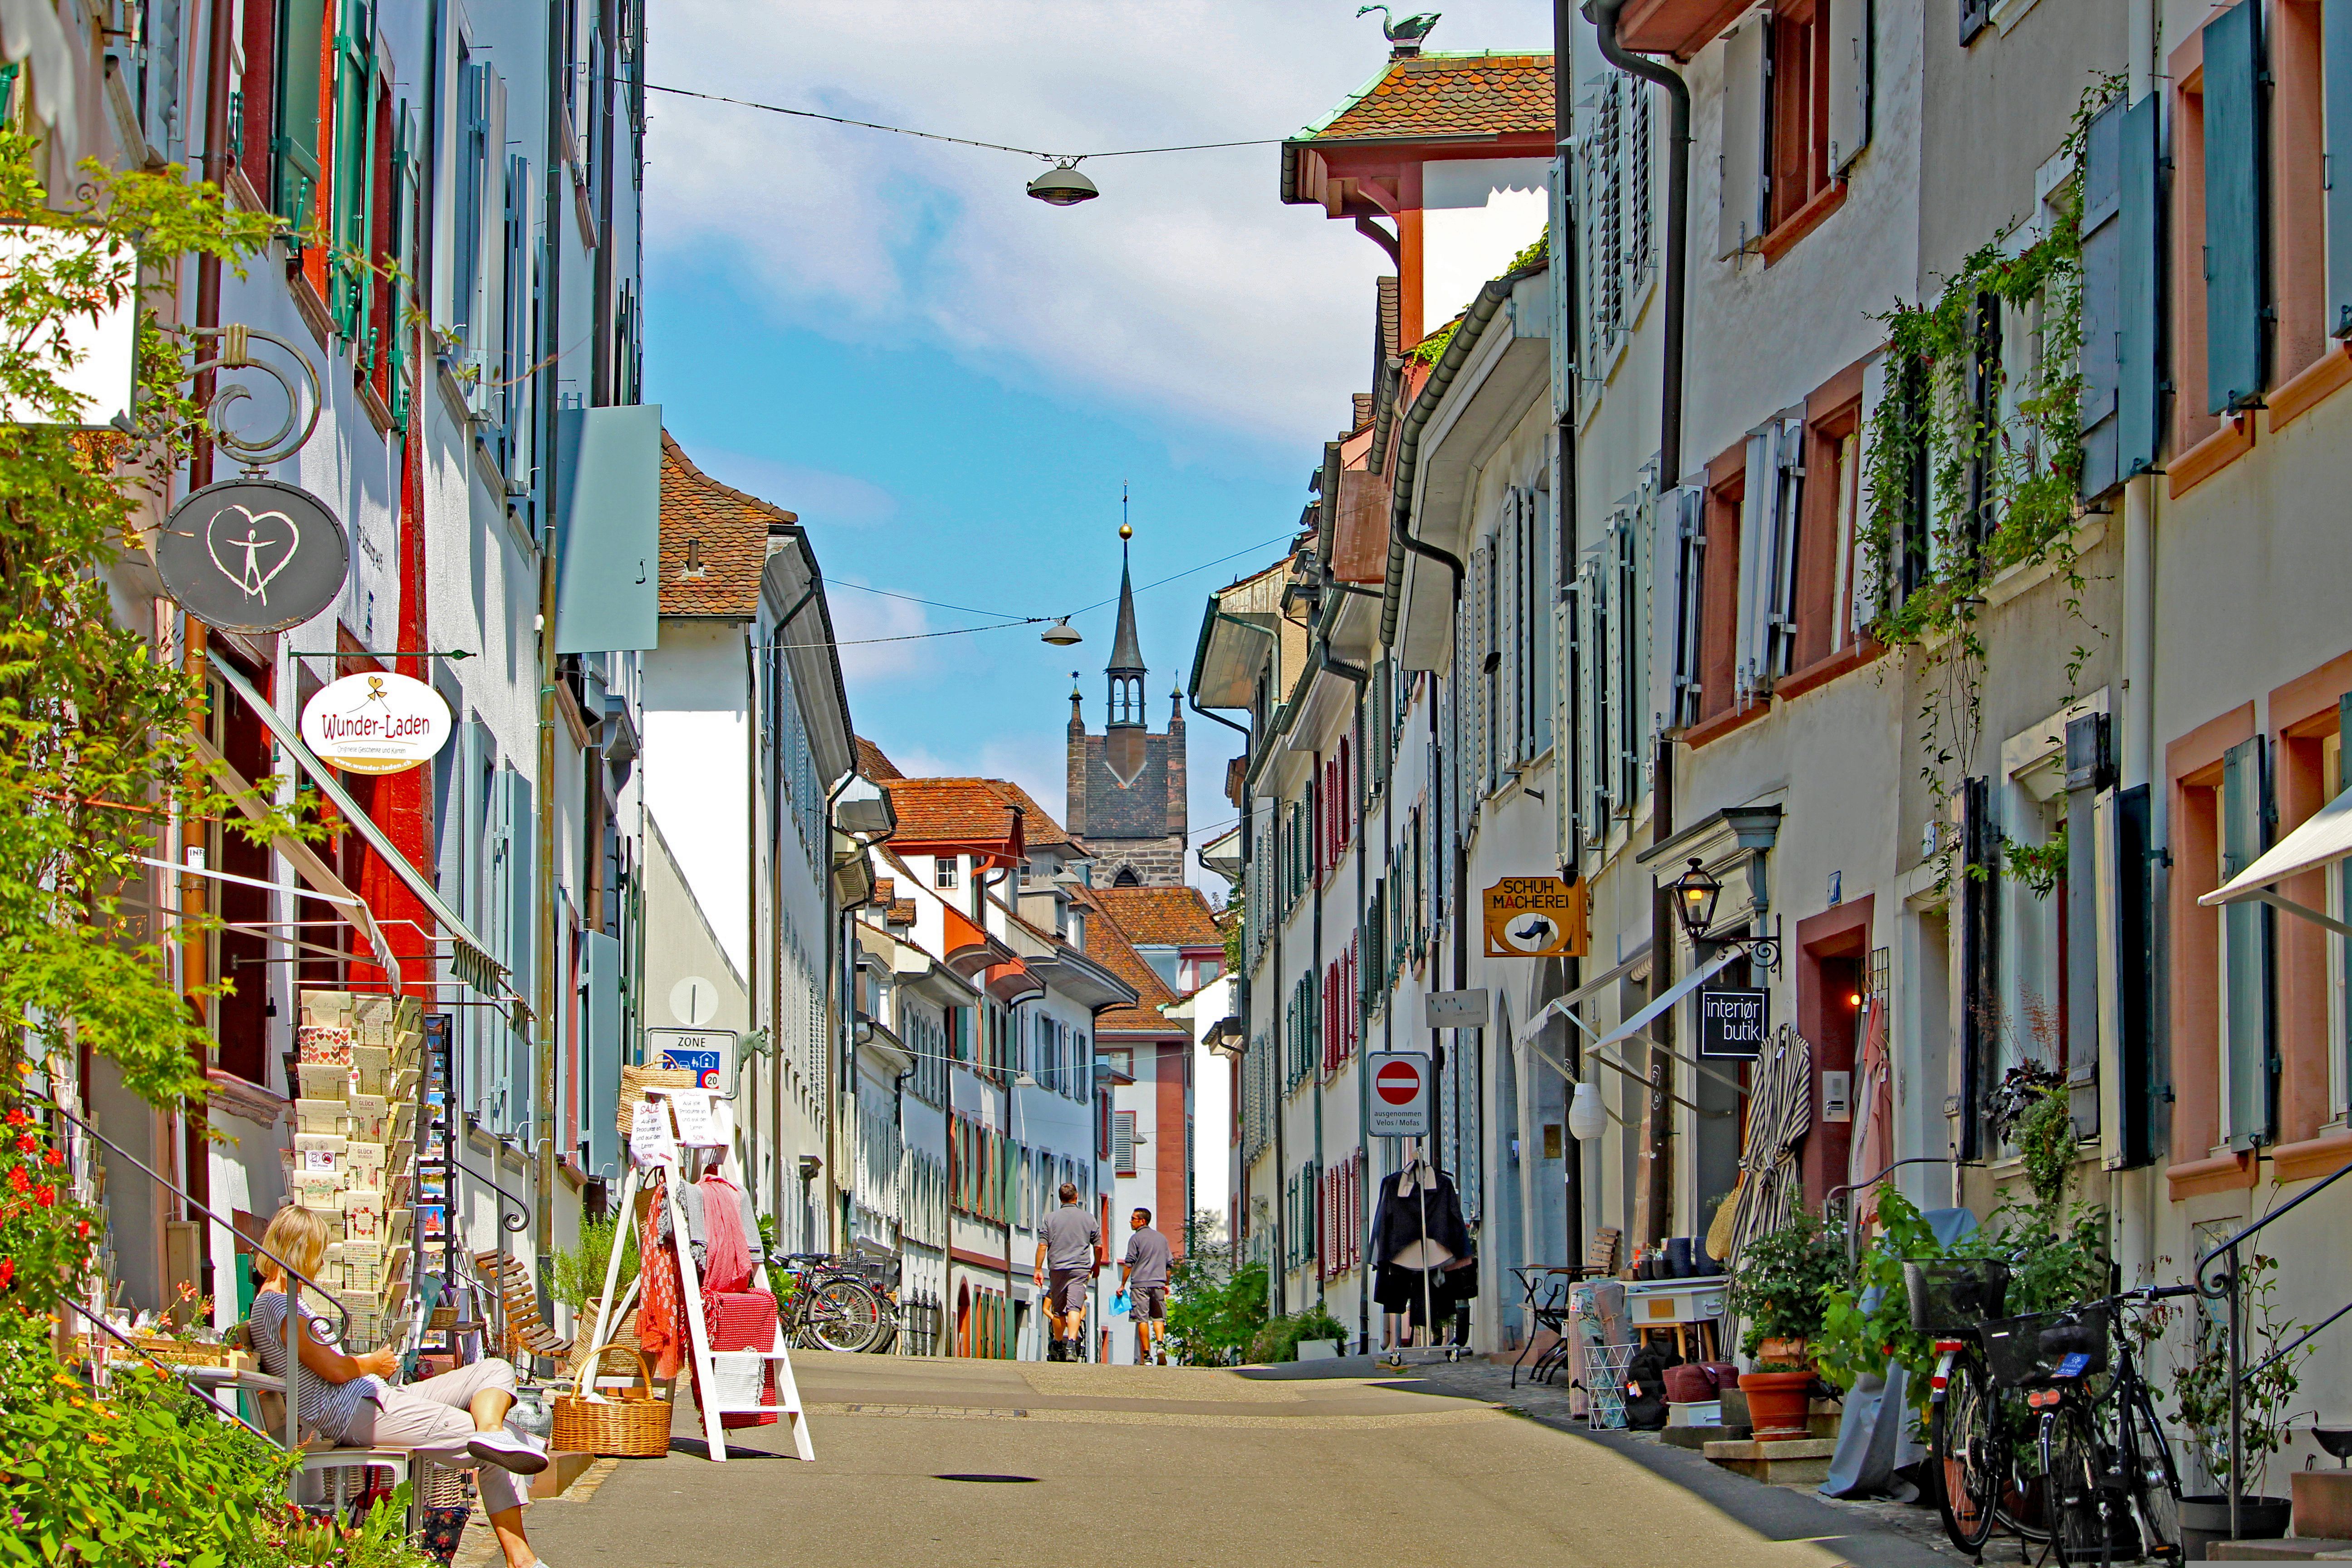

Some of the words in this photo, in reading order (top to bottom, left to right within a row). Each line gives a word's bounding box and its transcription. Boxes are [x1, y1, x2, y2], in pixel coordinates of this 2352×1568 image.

[322, 714, 430, 740] Wunder-Laden
[334, 757, 412, 771] www.wunder-laden.ch
[1504, 880, 1553, 894] SCHUH
[1493, 895, 1568, 908] MACHEREI
[1707, 997, 1759, 1019] interiør
[1724, 1019, 1759, 1040] butik
[678, 1037, 706, 1047] ZONE
[640, 1104, 659, 1115] SALE
